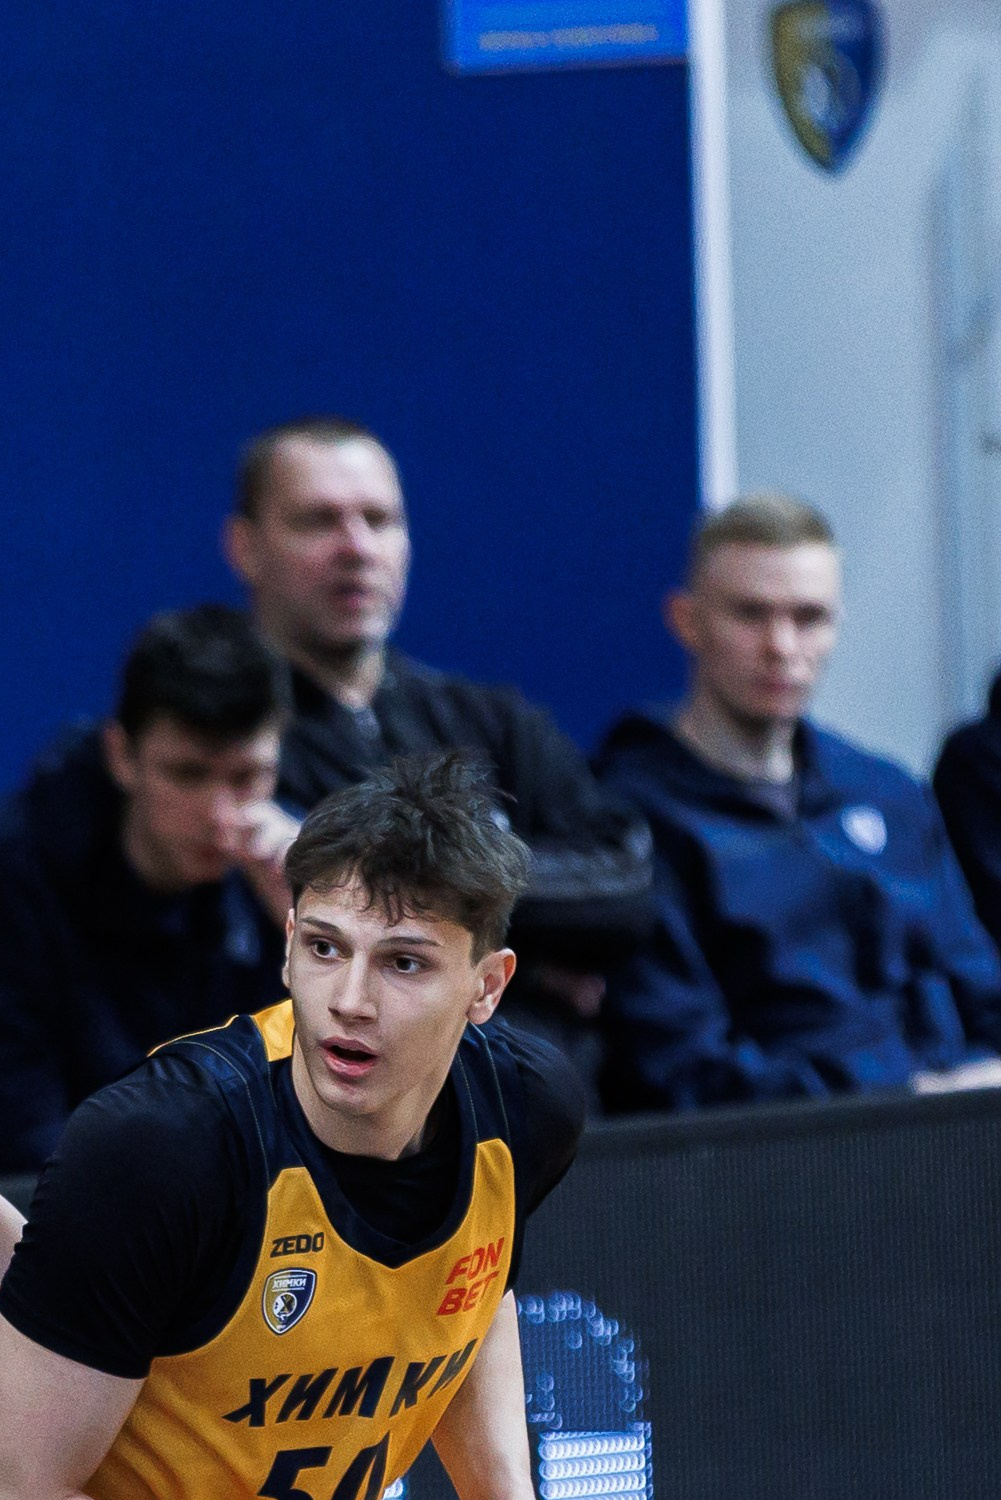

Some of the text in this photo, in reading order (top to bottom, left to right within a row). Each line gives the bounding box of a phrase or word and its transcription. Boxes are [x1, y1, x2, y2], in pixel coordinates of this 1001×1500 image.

[269, 1231, 325, 1258] ZEDO
[444, 1236, 505, 1285] FON
[436, 1269, 501, 1316] BET
[221, 1337, 478, 1428] ХИМКИ
